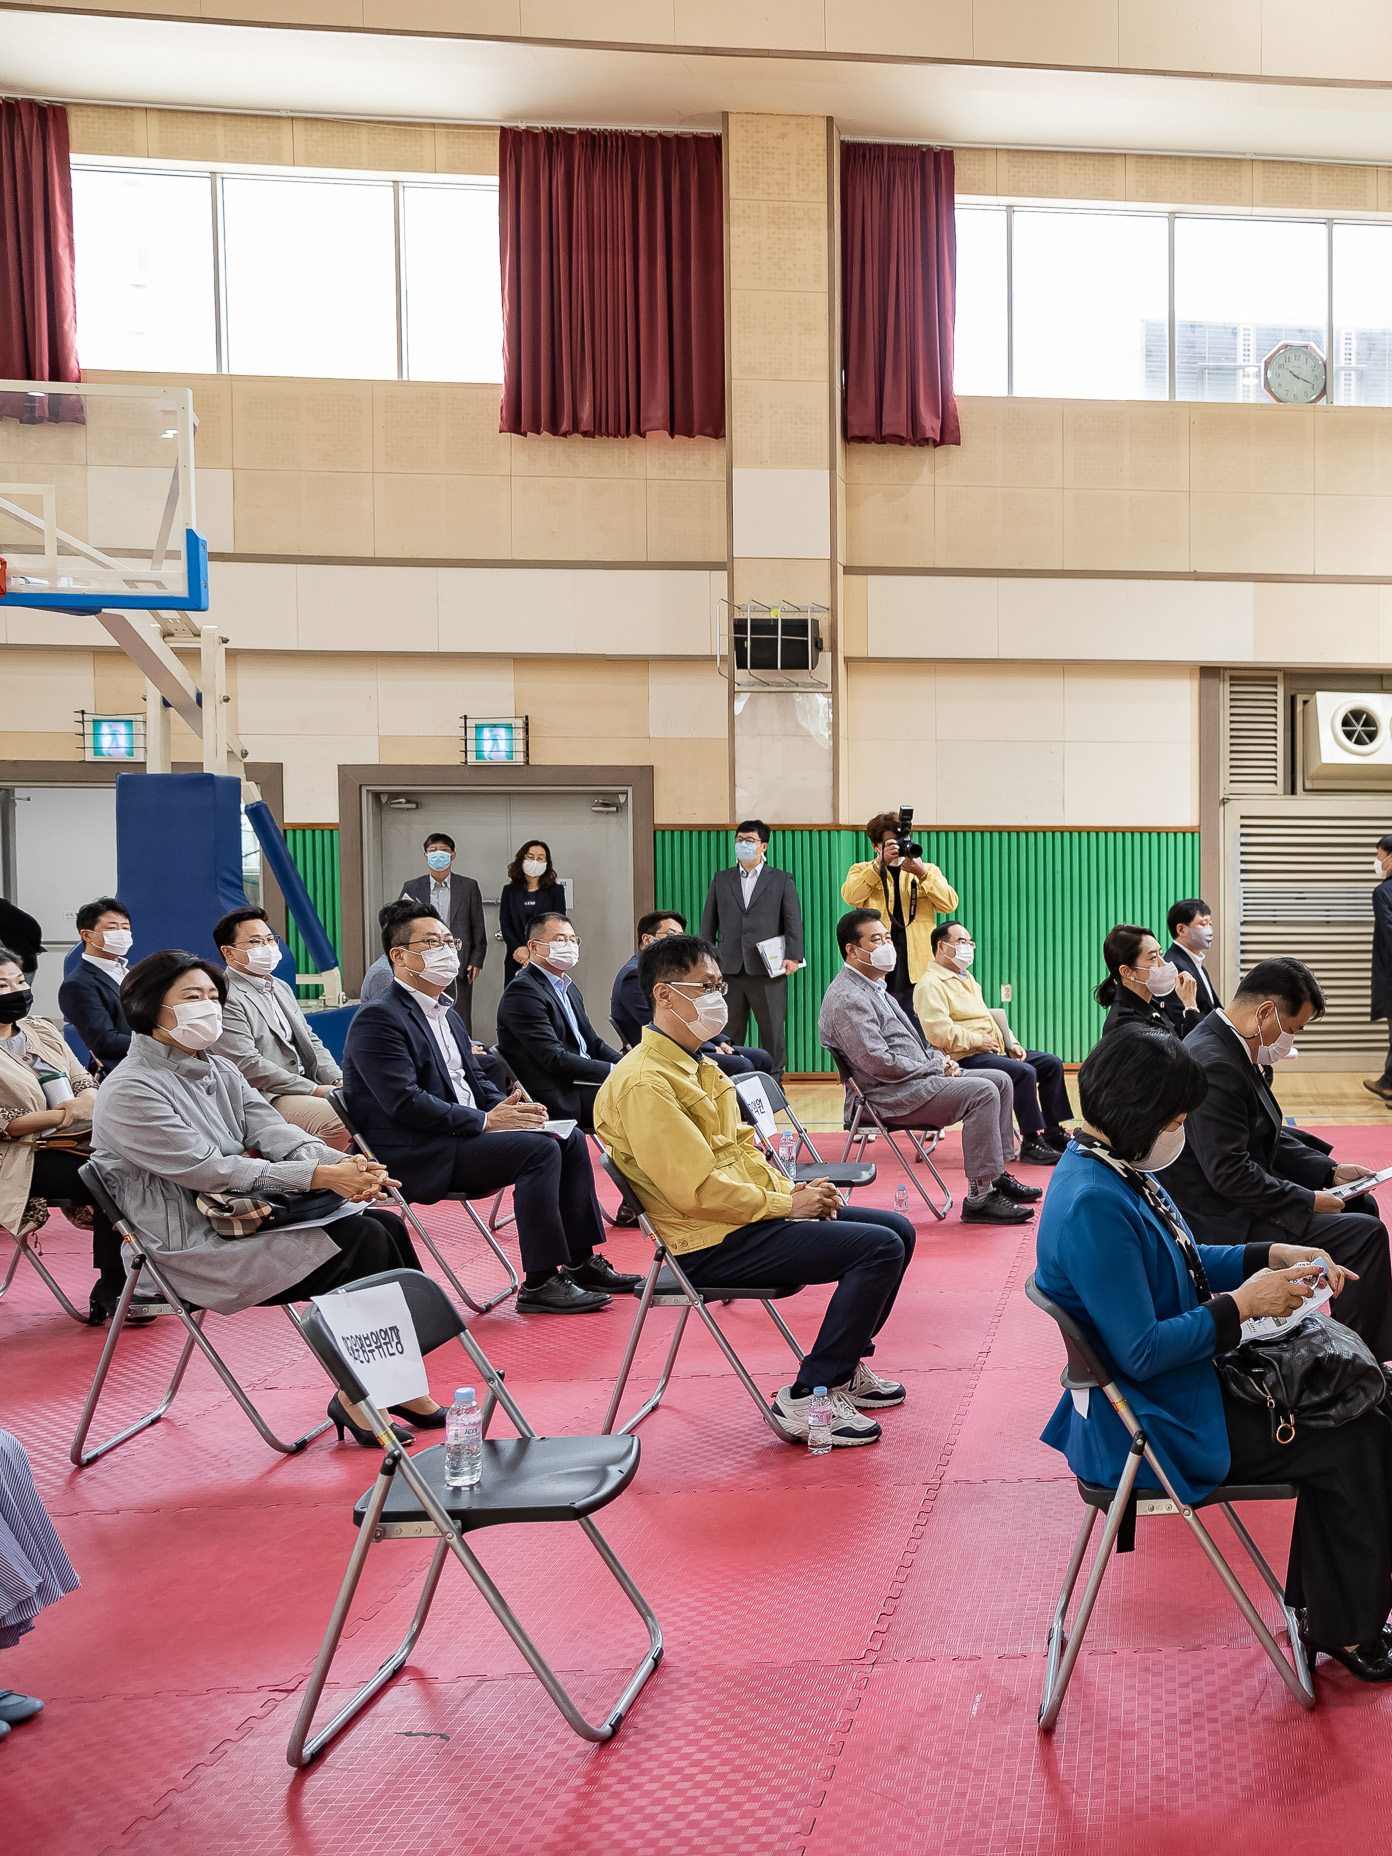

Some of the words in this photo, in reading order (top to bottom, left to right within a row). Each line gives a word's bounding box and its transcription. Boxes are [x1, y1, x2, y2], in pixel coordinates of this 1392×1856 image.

[1284, 356, 1291, 364] 11
[1293, 353, 1301, 361] 12
[1277, 362, 1285, 370] 10
